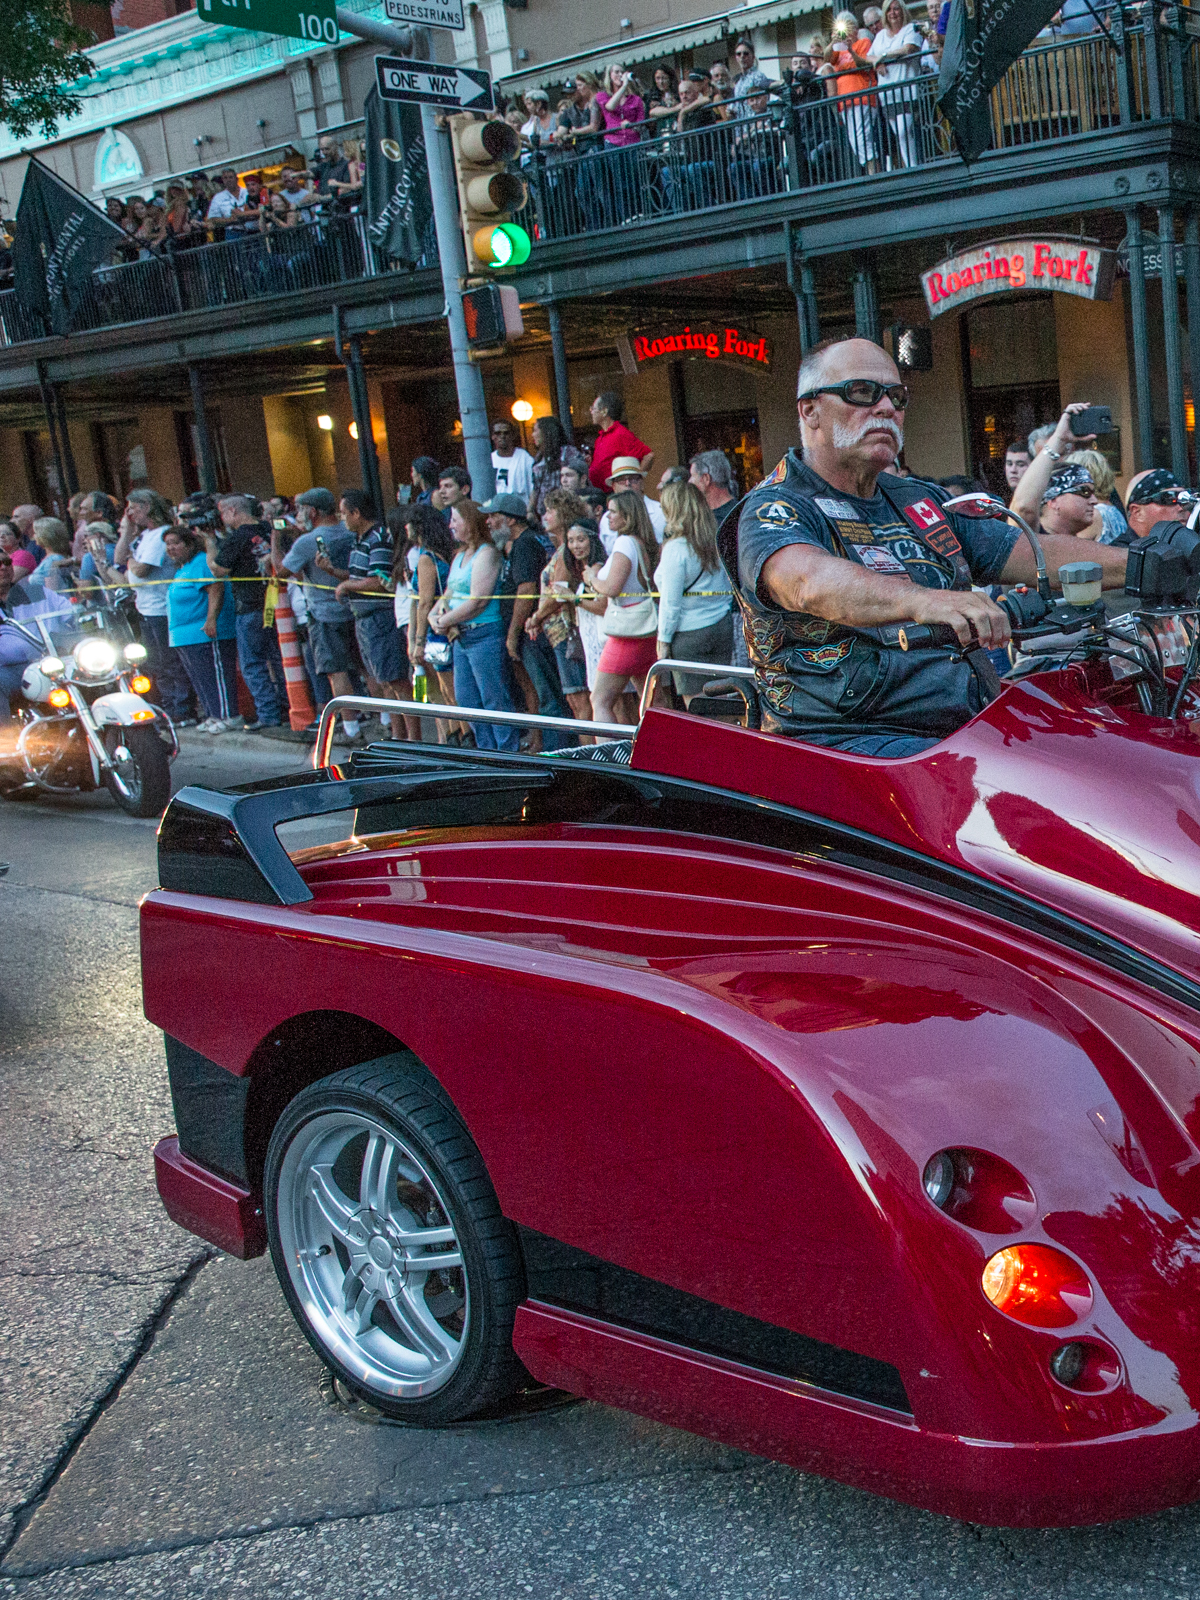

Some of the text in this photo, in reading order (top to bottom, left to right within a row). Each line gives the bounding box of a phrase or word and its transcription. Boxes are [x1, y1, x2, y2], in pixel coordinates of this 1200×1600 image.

[299, 12, 338, 44] 100
[389, 2, 461, 25] PEDESTRIANS
[390, 71, 459, 96] ONE WAY
[927, 243, 1094, 304] Roaring Fork
[634, 326, 770, 365] Roaring Fork
